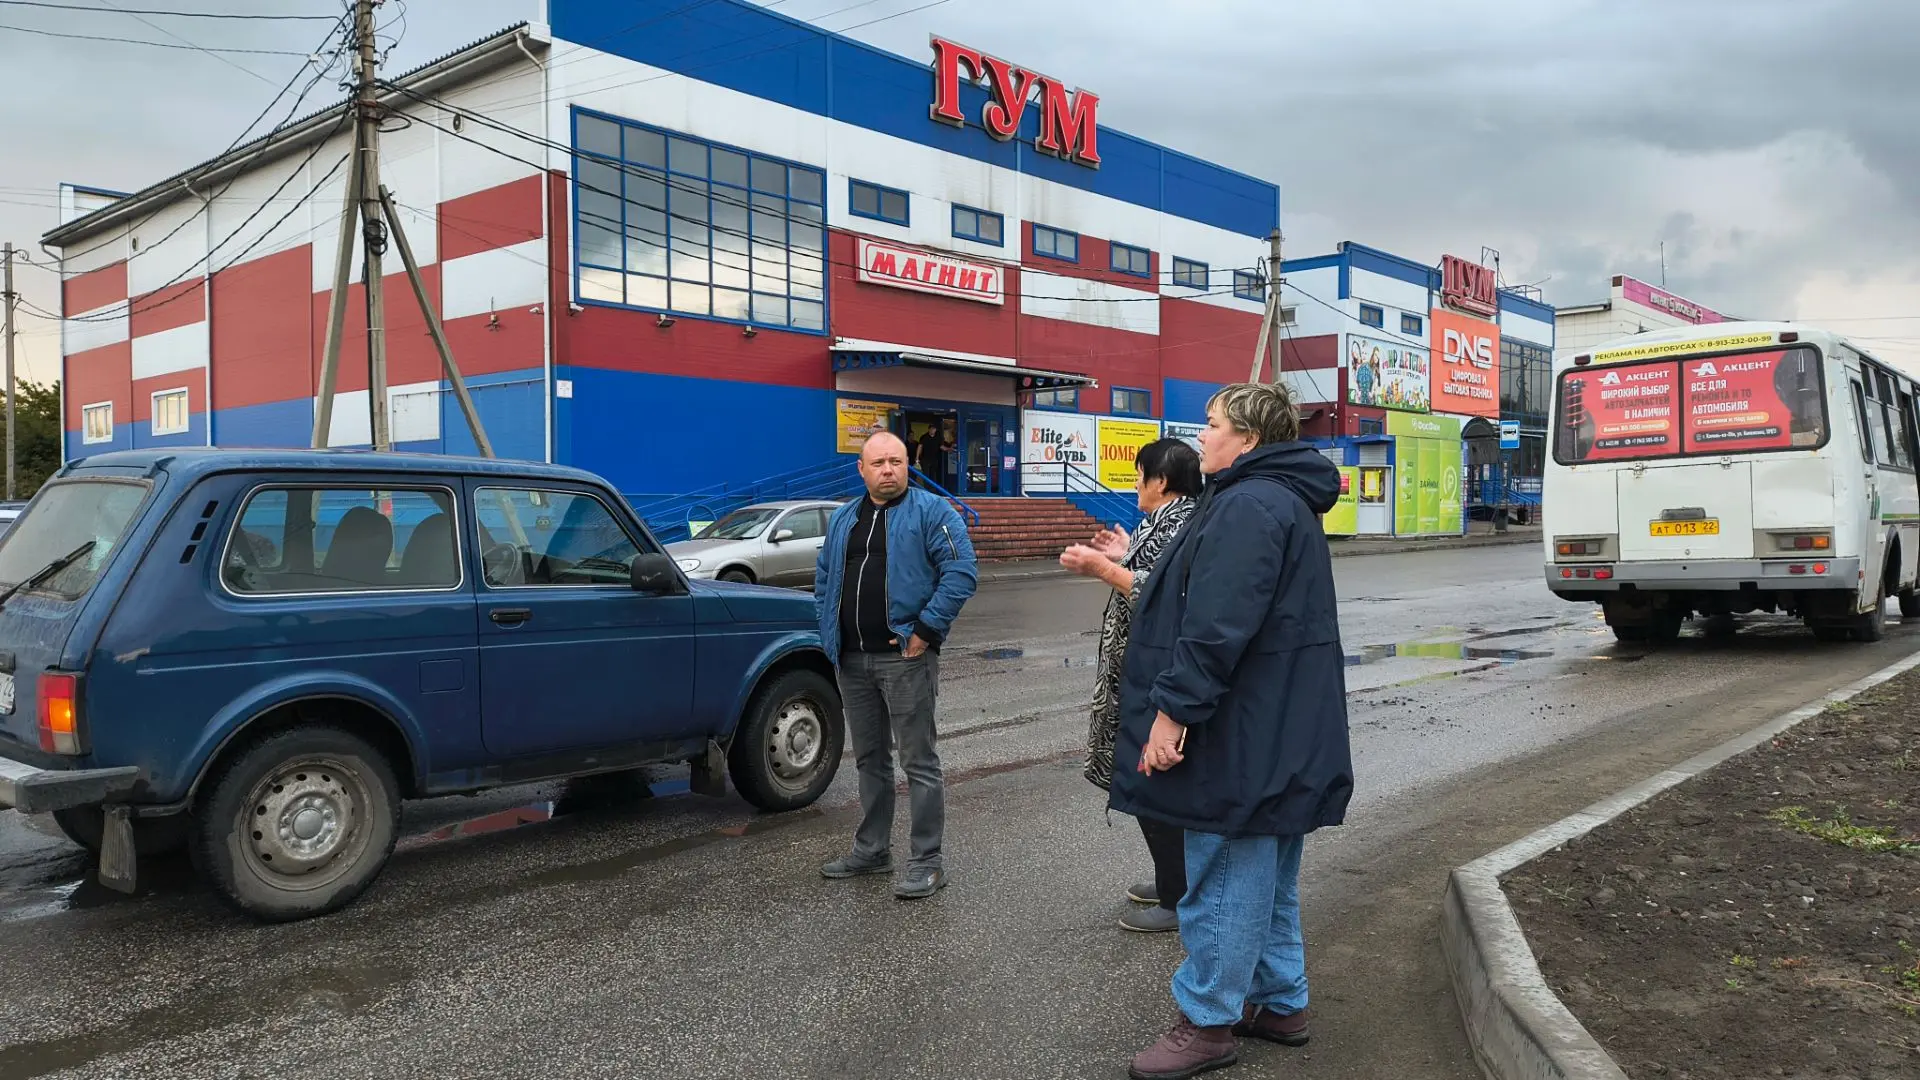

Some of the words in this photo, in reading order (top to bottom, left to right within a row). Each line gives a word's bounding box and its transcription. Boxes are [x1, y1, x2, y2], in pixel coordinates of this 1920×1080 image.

[931, 37, 1101, 165] ГУМ
[871, 251, 993, 293] МАГНИТ
[1443, 254, 1497, 307] ЦУМ
[1443, 328, 1493, 370] DNS
[1594, 351, 1633, 360] РЕКЛАМА
[1647, 342, 1697, 353] АВТОБУСАХ
[1707, 335, 1772, 347] 8-913-232-00-99
[1722, 360, 1772, 373] АКЦЕНТ
[1451, 369, 1482, 384] ЦИФРОВАЯ
[1625, 370, 1670, 382] АКЦЕНТ
[1444, 382, 1470, 396] БЫТОВАЯ
[1470, 386, 1493, 400] ТЕХНИКА
[1601, 386, 1640, 399] ШИРОКИЙ
[1641, 385, 1670, 396] ВЫБОР
[1691, 381, 1707, 392] ВСЕ
[1708, 379, 1727, 391] ДЛЯ
[1691, 391, 1730, 402] РЕМОНТА
[1741, 388, 1752, 398] ТО
[1604, 396, 1671, 409] АВТОЗАПЧАСТЕЙ
[1692, 401, 1749, 415] АВТОМОБИЛЯ
[1624, 410, 1631, 419] В
[1631, 407, 1670, 418] НАЛИЧИИ
[1031, 428, 1063, 444] Elite
[1044, 443, 1087, 464] Обувь
[1656, 526, 1669, 534] АТ
[1674, 522, 1697, 534] 013
[1703, 521, 1714, 530] 22
